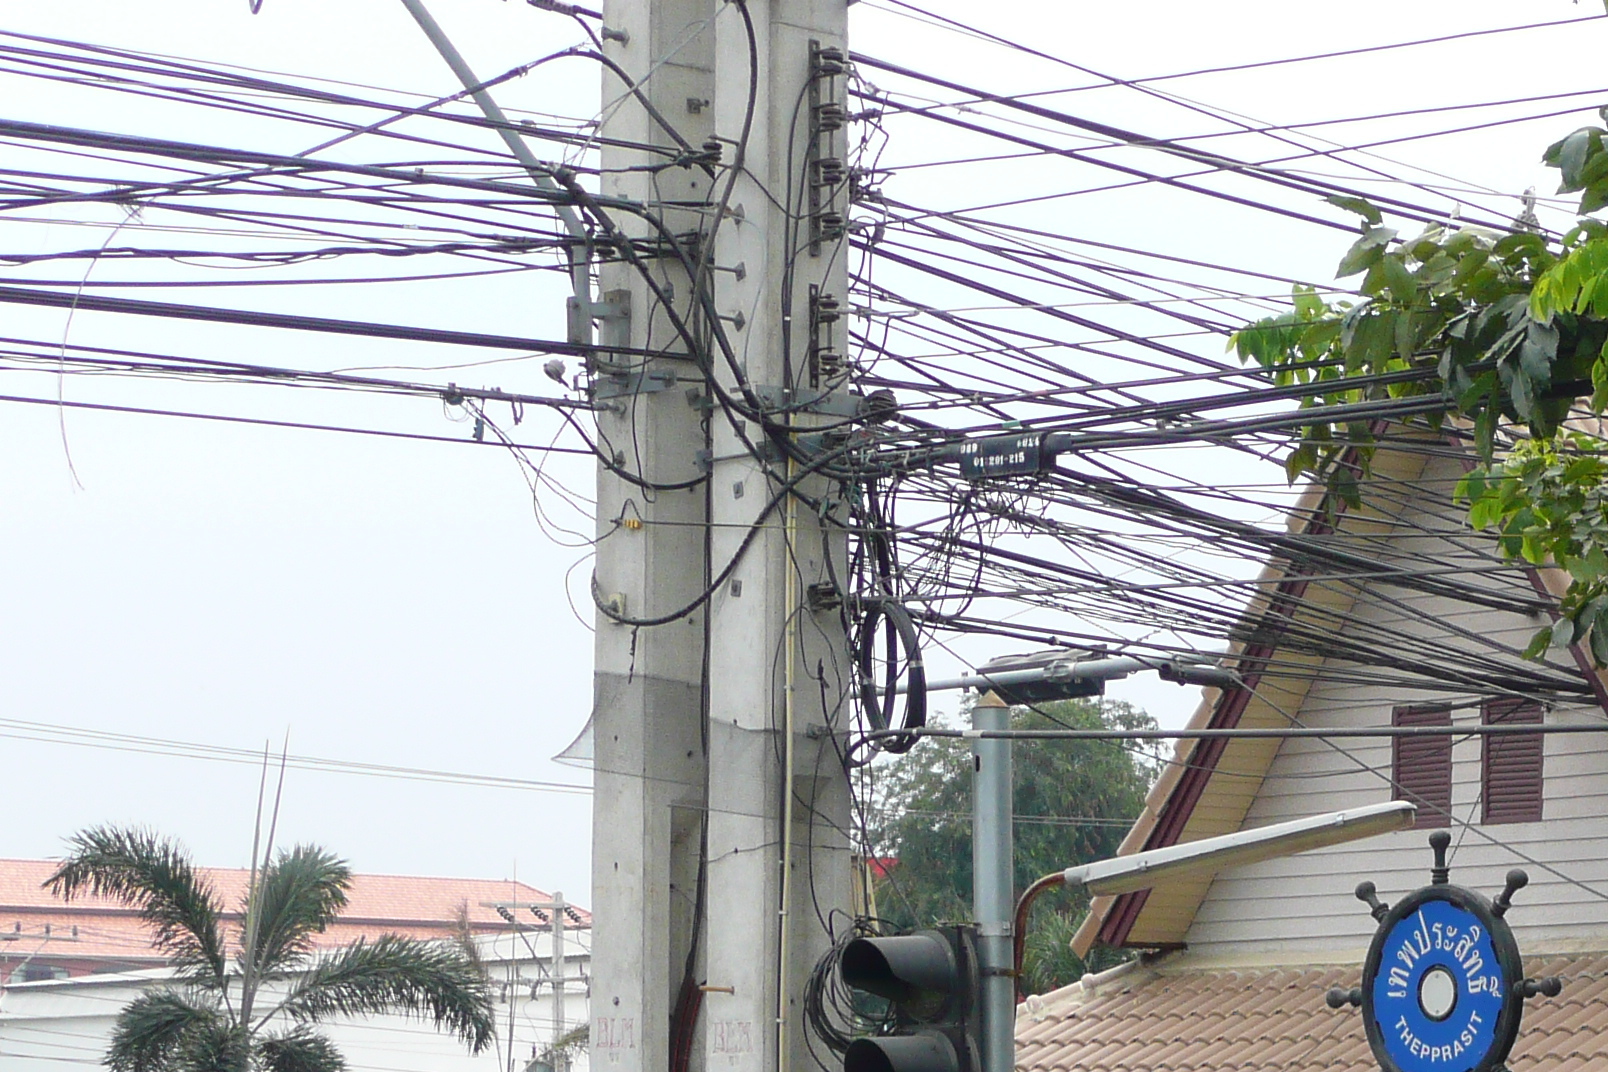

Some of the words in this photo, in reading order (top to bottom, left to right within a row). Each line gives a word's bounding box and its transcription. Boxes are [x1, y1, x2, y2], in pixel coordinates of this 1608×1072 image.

[1387, 908, 1503, 998] เทพประสิทธิ์
[1394, 1009, 1483, 1063] THEPPRASIT
